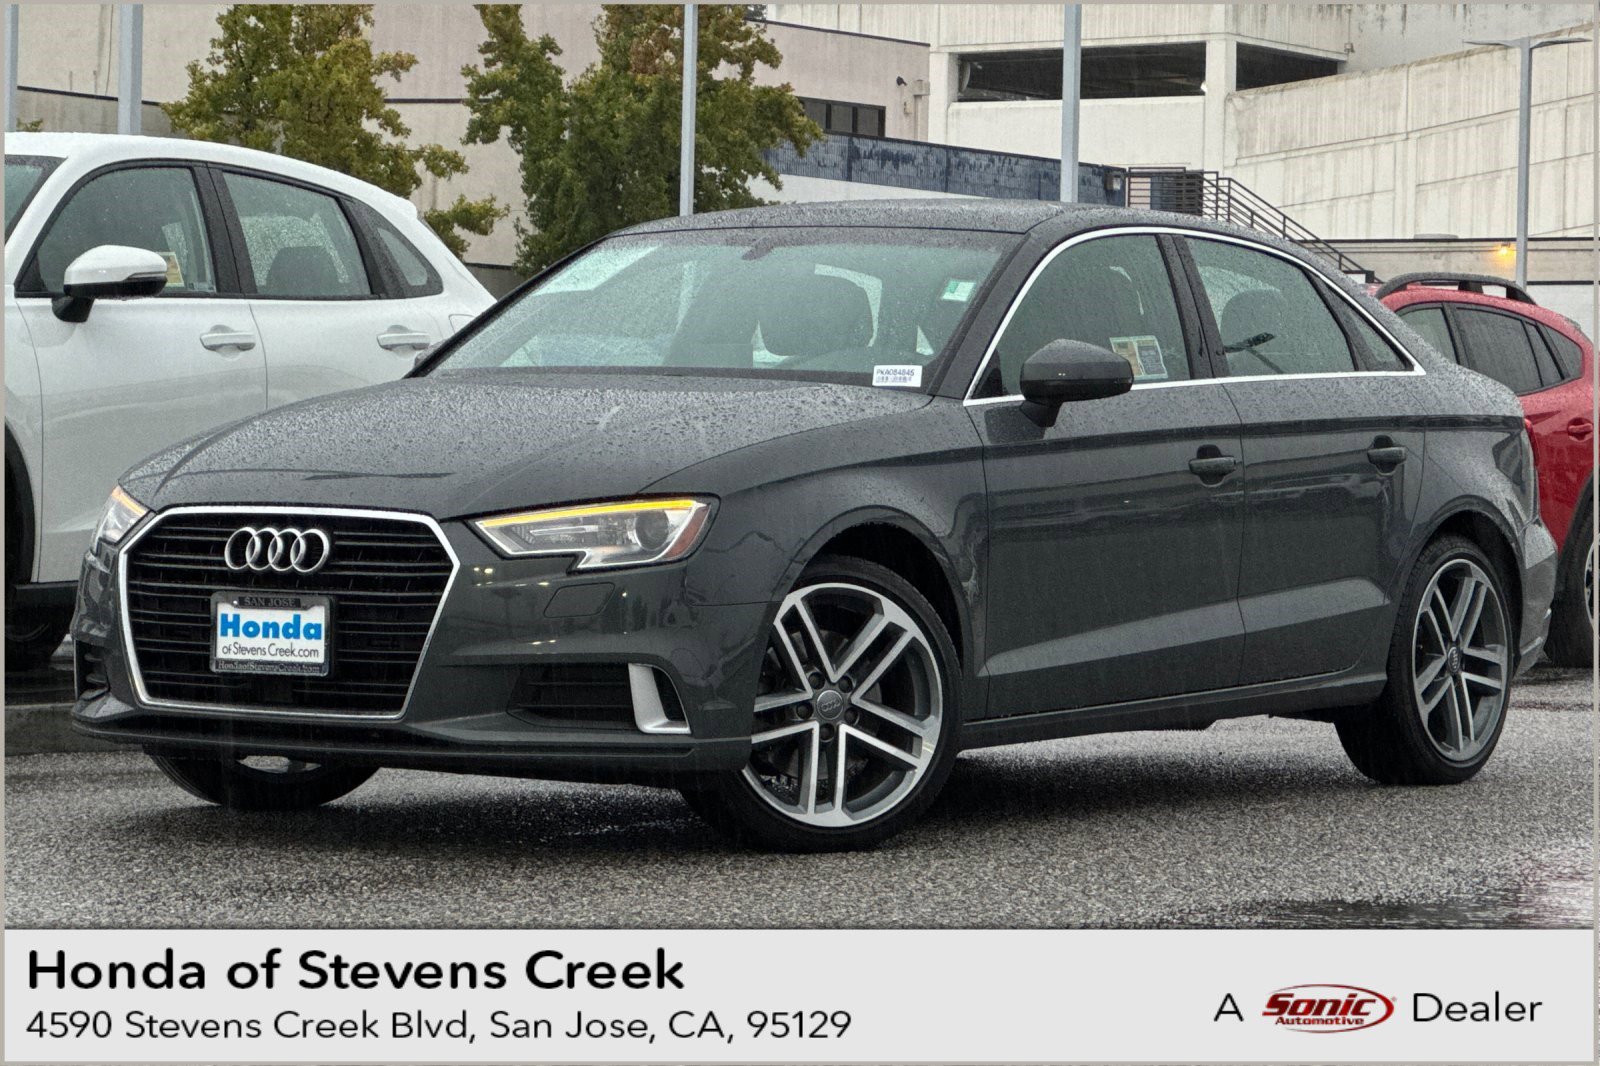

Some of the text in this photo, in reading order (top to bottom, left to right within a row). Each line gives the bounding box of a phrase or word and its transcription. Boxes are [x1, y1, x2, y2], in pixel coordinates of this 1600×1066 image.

[244, 596, 296, 607] SAN JOSE
[220, 613, 322, 640] Honda
